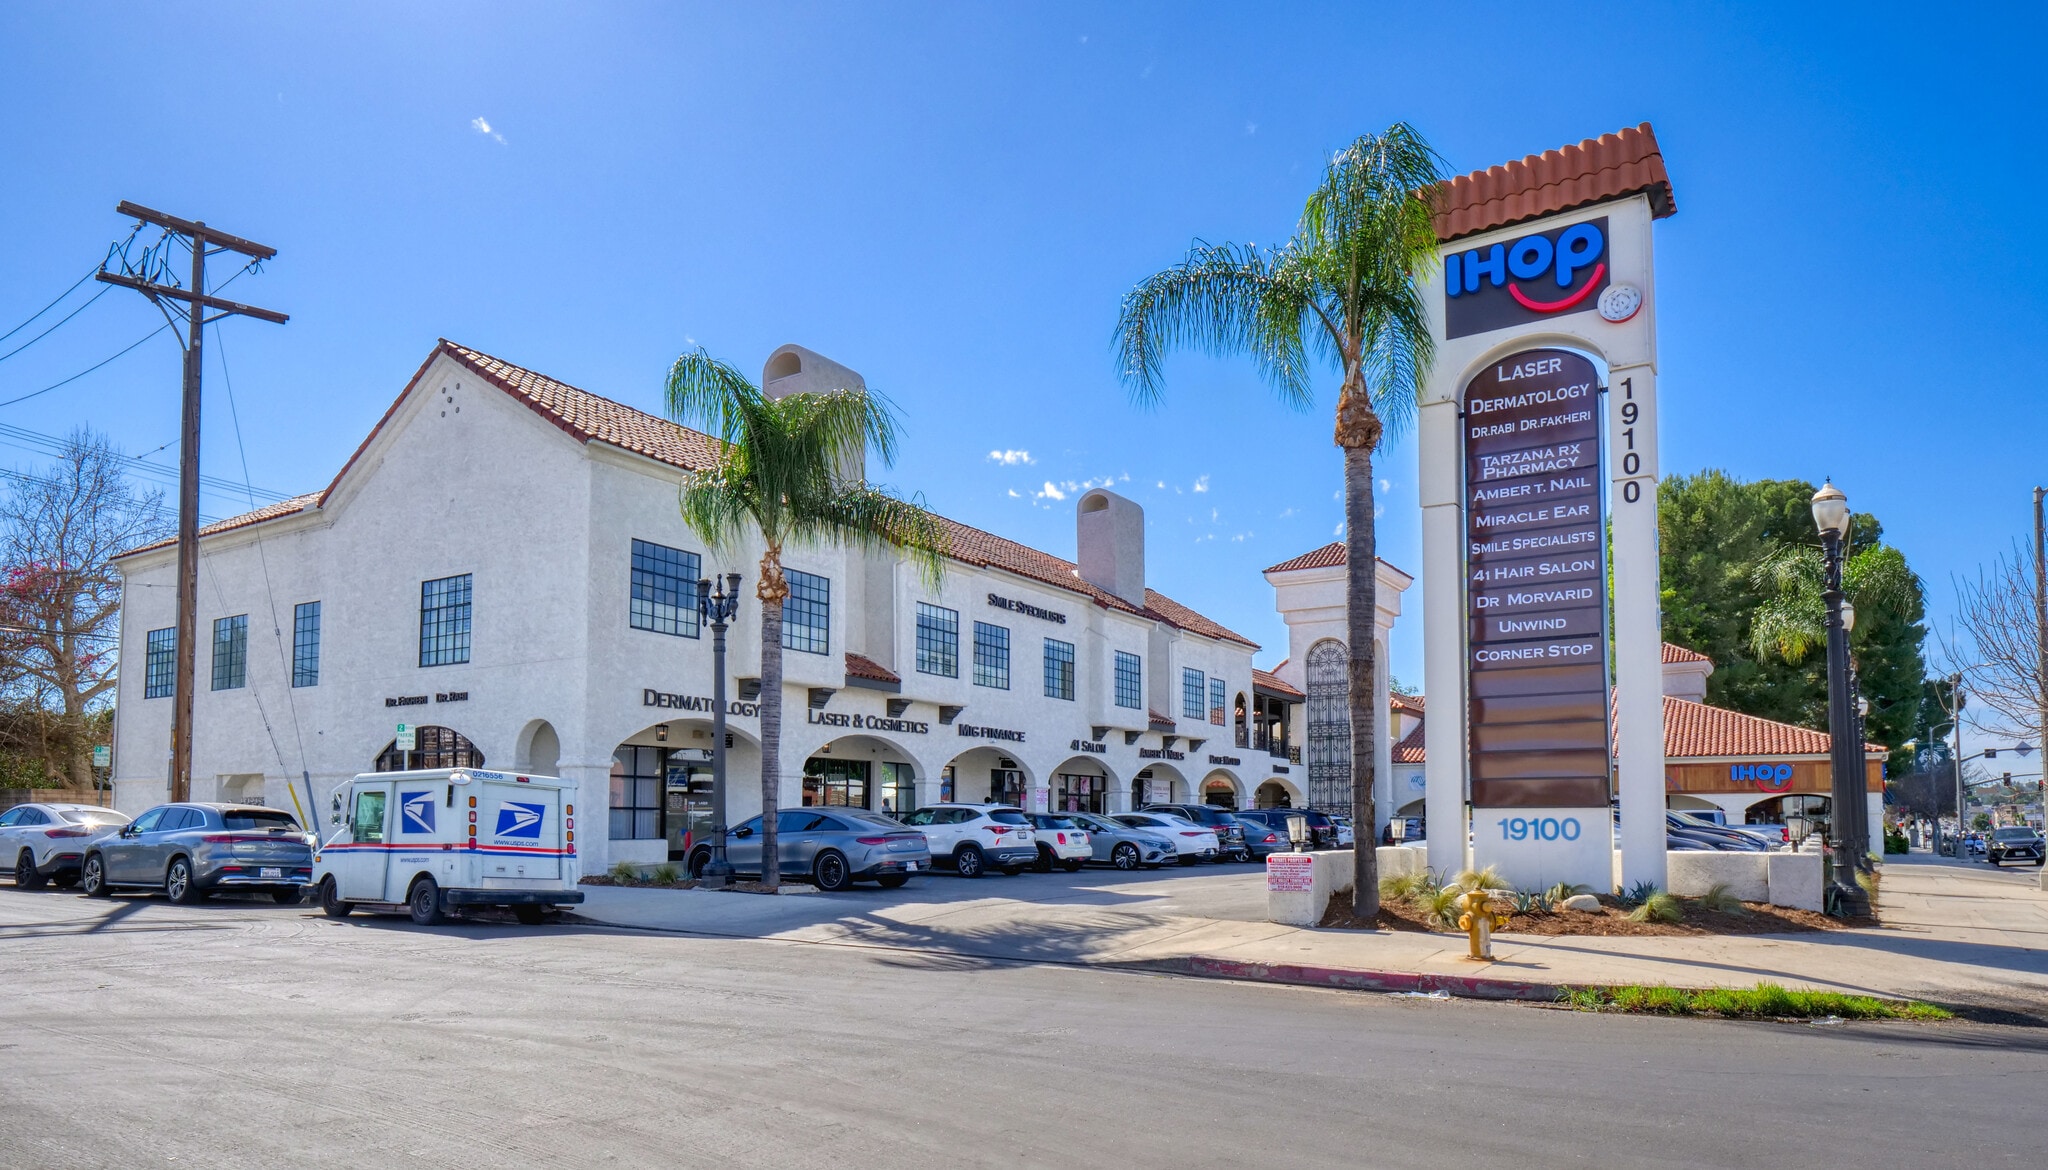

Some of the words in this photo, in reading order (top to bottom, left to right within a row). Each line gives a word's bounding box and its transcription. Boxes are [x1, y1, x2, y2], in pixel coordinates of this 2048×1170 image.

[1446, 223, 1604, 298] IHOP
[1471, 384, 1590, 415] DERMATOLOGY
[1481, 448, 1555, 468] TARZANA
[1559, 443, 1581, 457] RX
[1483, 456, 1579, 479] PHARMACY
[1473, 485, 1531, 502] AMBER
[1550, 477, 1591, 492] NAIL
[1475, 509, 1549, 528] MIRACLE
[1553, 504, 1590, 519] EAR
[1472, 540, 1510, 555] SMILE
[1512, 531, 1596, 550] SPECIALISTS
[1473, 569, 1491, 581] 41
[1494, 566, 1535, 580] HAIR
[1539, 559, 1596, 575] SALON
[988, 593, 1016, 611] SMILE
[1015, 600, 1066, 624] SPECIALISTS
[1476, 596, 1500, 609] DR
[1507, 588, 1593, 606] MORVARID
[1499, 618, 1567, 633] UNWIND
[1475, 647, 1544, 662] CORNER
[1548, 644, 1594, 658] STOP
[643, 688, 761, 718] DERMATLOGY
[808, 708, 850, 727] LASER
[853, 714, 864, 728] &
[866, 715, 929, 734] COSMETICS
[1081, 740, 1106, 754] SALON
[1731, 763, 1793, 786] IHOP
[1497, 817, 1581, 841] 19100
